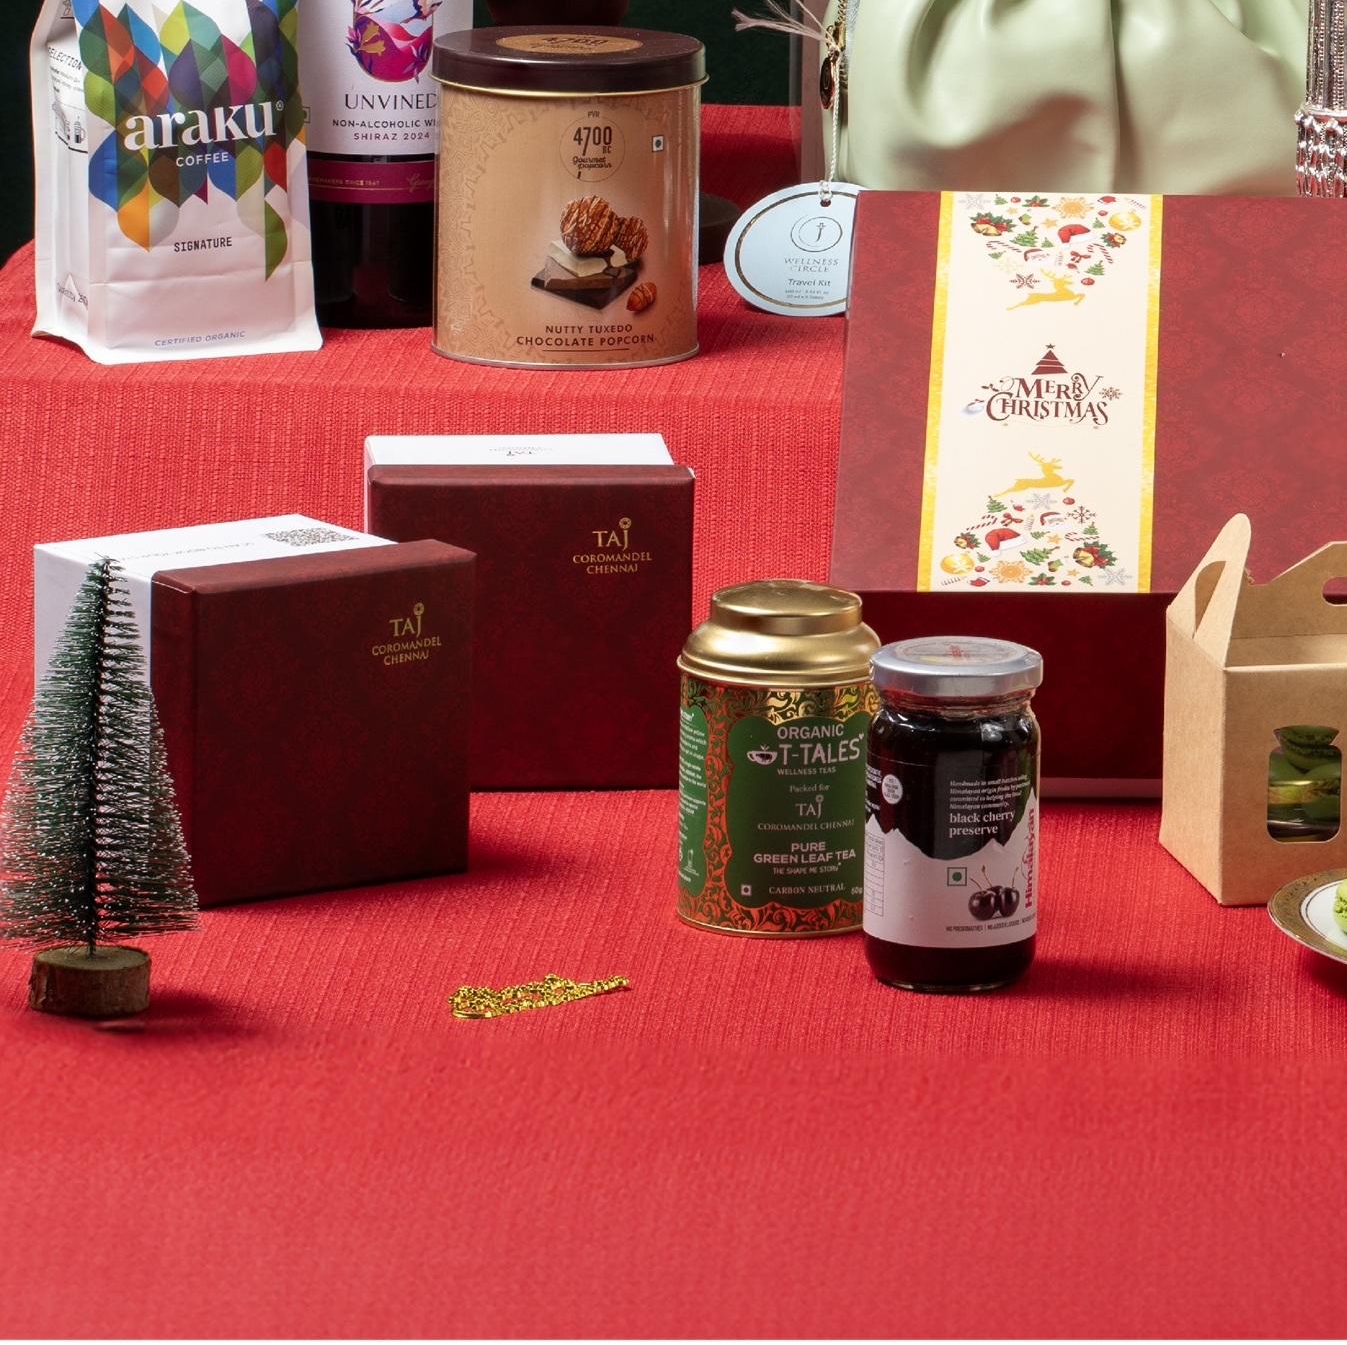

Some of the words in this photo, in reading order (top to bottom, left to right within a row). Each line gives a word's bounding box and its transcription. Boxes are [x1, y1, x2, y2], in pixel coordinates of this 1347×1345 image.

[345, 93, 437, 110] UNVINED
[123, 101, 278, 152] araku
[333, 119, 421, 128] NON-ALCOHOLIC
[424, 119, 437, 127] WI
[353, 133, 398, 141] SHIRAZ
[403, 132, 430, 140] 2024
[573, 126, 613, 156] 4700
[602, 146, 612, 154] BC
[175, 151, 229, 168] COFFEE
[174, 237, 232, 253] SIGNATURE
[790, 265, 830, 273] CIRCLE
[788, 278, 816, 286] Travel
[818, 279, 831, 287] Kit
[545, 325, 584, 334] NUTTY
[588, 324, 633, 333] TUXEDO
[155, 336, 202, 346] CERTIFIED
[205, 331, 246, 341] ORGANIC
[516, 336, 594, 346] CHOCOLATE
[600, 334, 654, 346] POPCORN
[592, 530, 629, 551] TAJ
[572, 552, 652, 564] COROMANDEL
[586, 564, 638, 574] CHENNAI
[389, 616, 422, 638] TAJ
[372, 636, 442, 656] COROMANDEL
[384, 649, 429, 666] CHENNAI
[777, 724, 844, 739] ORGANIC
[779, 738, 860, 765] T-TALES
[790, 784, 817, 792] Packed
[795, 802, 822, 818] TAJ
[949, 813, 980, 823] black
[983, 811, 1016, 822] cherry
[758, 822, 819, 831] COROMANDEL
[820, 819, 855, 830] CHENNAI
[949, 825, 998, 838] preserve
[791, 842, 826, 852] PURE
[754, 853, 798, 864] GREEN
[801, 853, 833, 863] LEAF
[835, 849, 856, 860] TEA
[769, 886, 806, 894] CARBON
[808, 883, 845, 893] NEUTRAL
